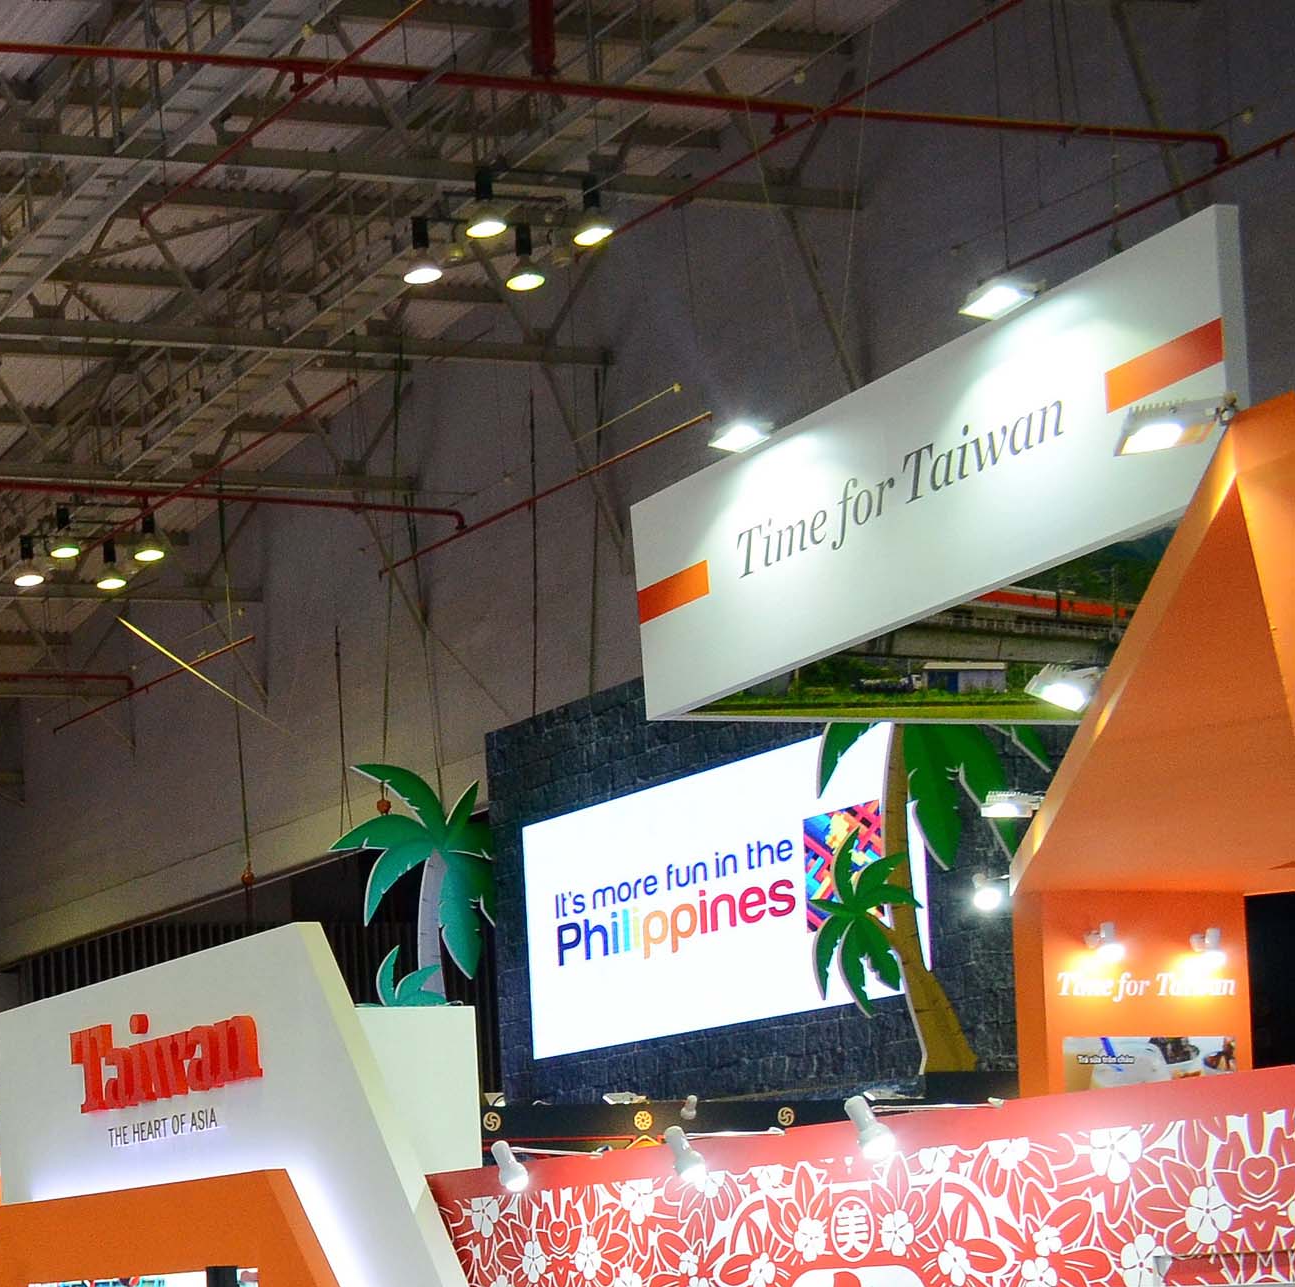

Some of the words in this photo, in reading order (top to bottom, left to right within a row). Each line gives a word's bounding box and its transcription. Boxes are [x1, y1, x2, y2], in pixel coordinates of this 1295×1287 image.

[737, 508, 828, 579] Time
[831, 476, 895, 551] for
[903, 399, 1064, 504] Taiwan
[555, 890, 586, 919] It's
[593, 874, 658, 910] more
[666, 861, 708, 890] fun
[715, 852, 738, 879] in
[746, 839, 793, 870] the
[557, 879, 796, 966] Philippines
[1113, 972, 1150, 1002] for
[70, 1013, 263, 1114] Taiwan
[108, 1122, 128, 1148] THE
[132, 1117, 168, 1143] HEART
[172, 1113, 186, 1135] OF
[190, 1107, 218, 1132] ASIA
[834, 1204, 870, 1256] 美
